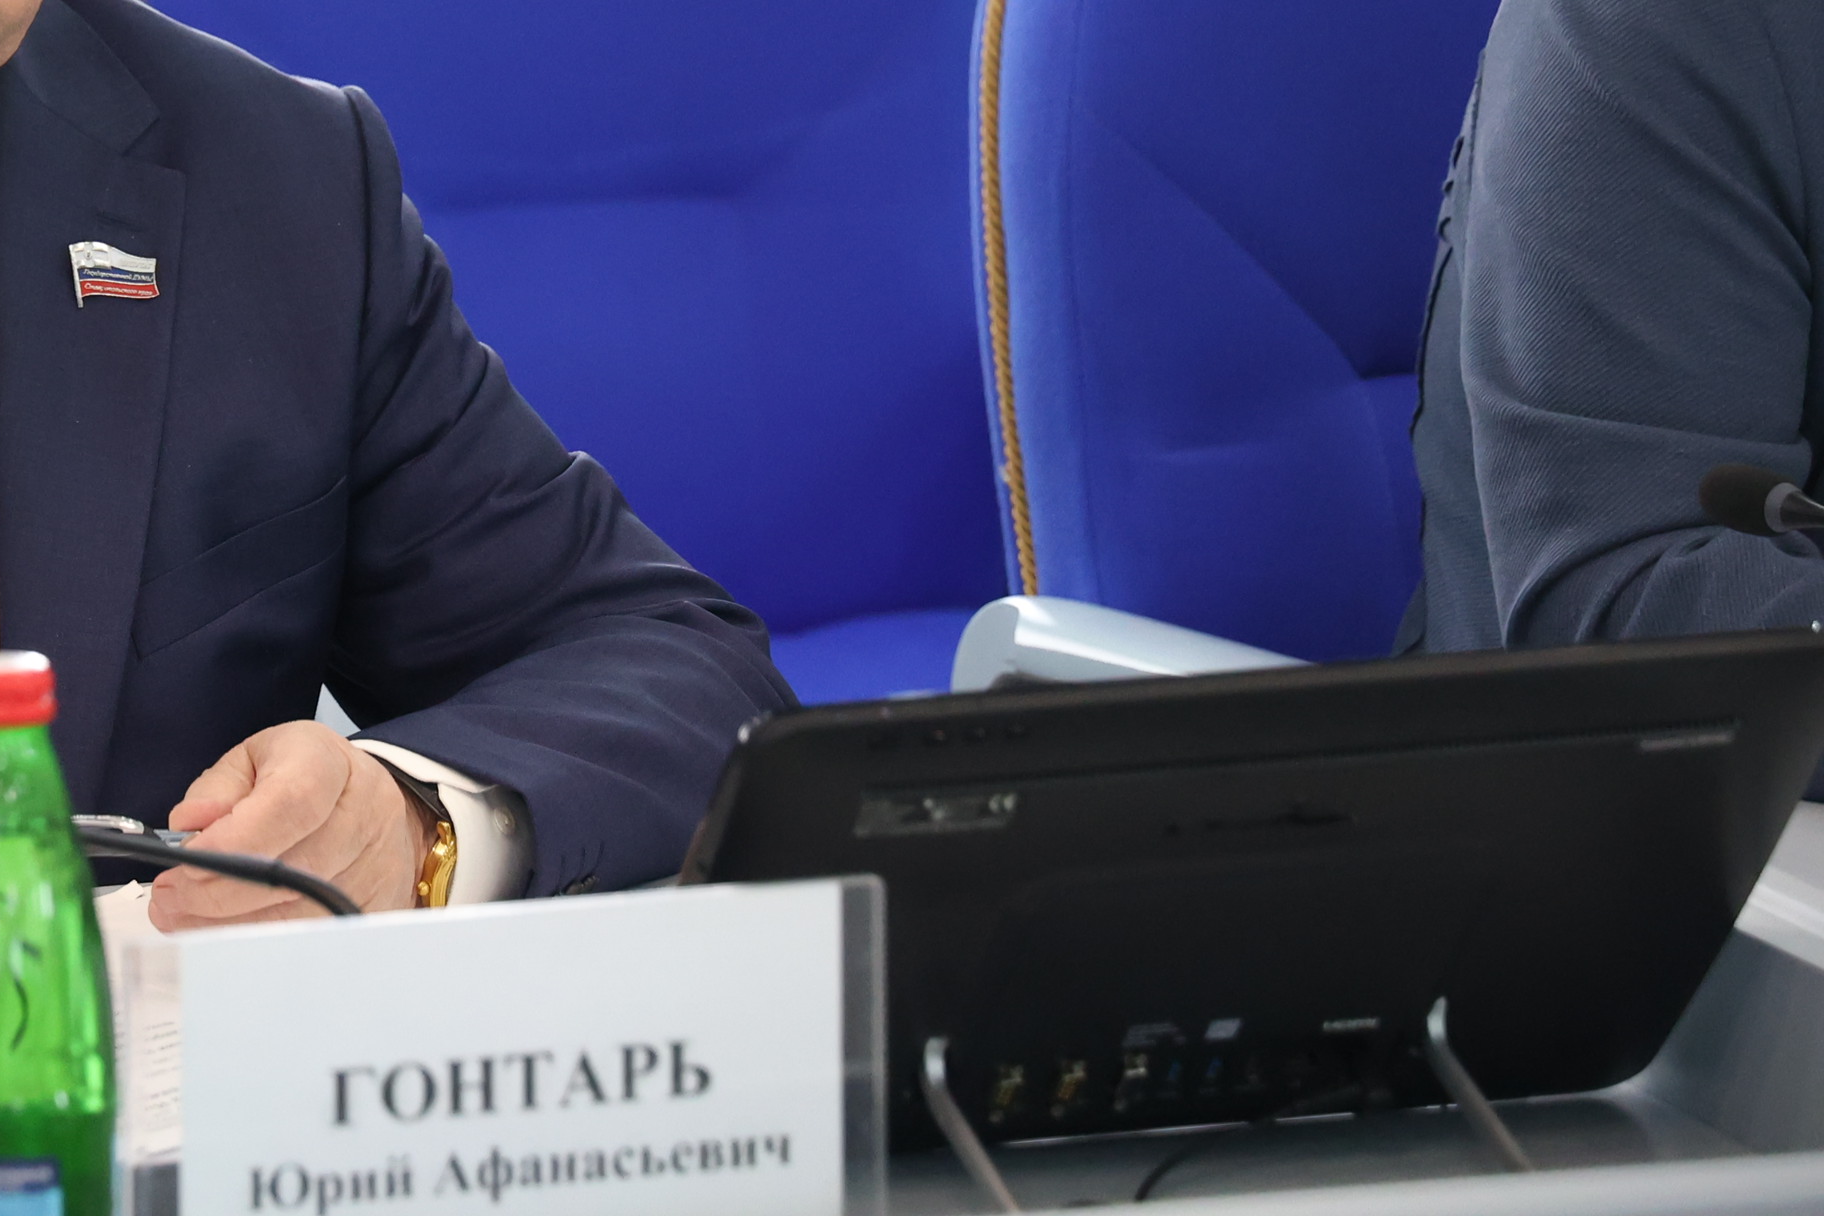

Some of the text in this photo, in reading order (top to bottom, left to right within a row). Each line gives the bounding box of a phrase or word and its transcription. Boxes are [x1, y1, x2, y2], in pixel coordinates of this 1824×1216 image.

[330, 1038, 713, 1127] ГОНТАРЬ
[249, 1130, 792, 1216] Юрий Афанасьевич
